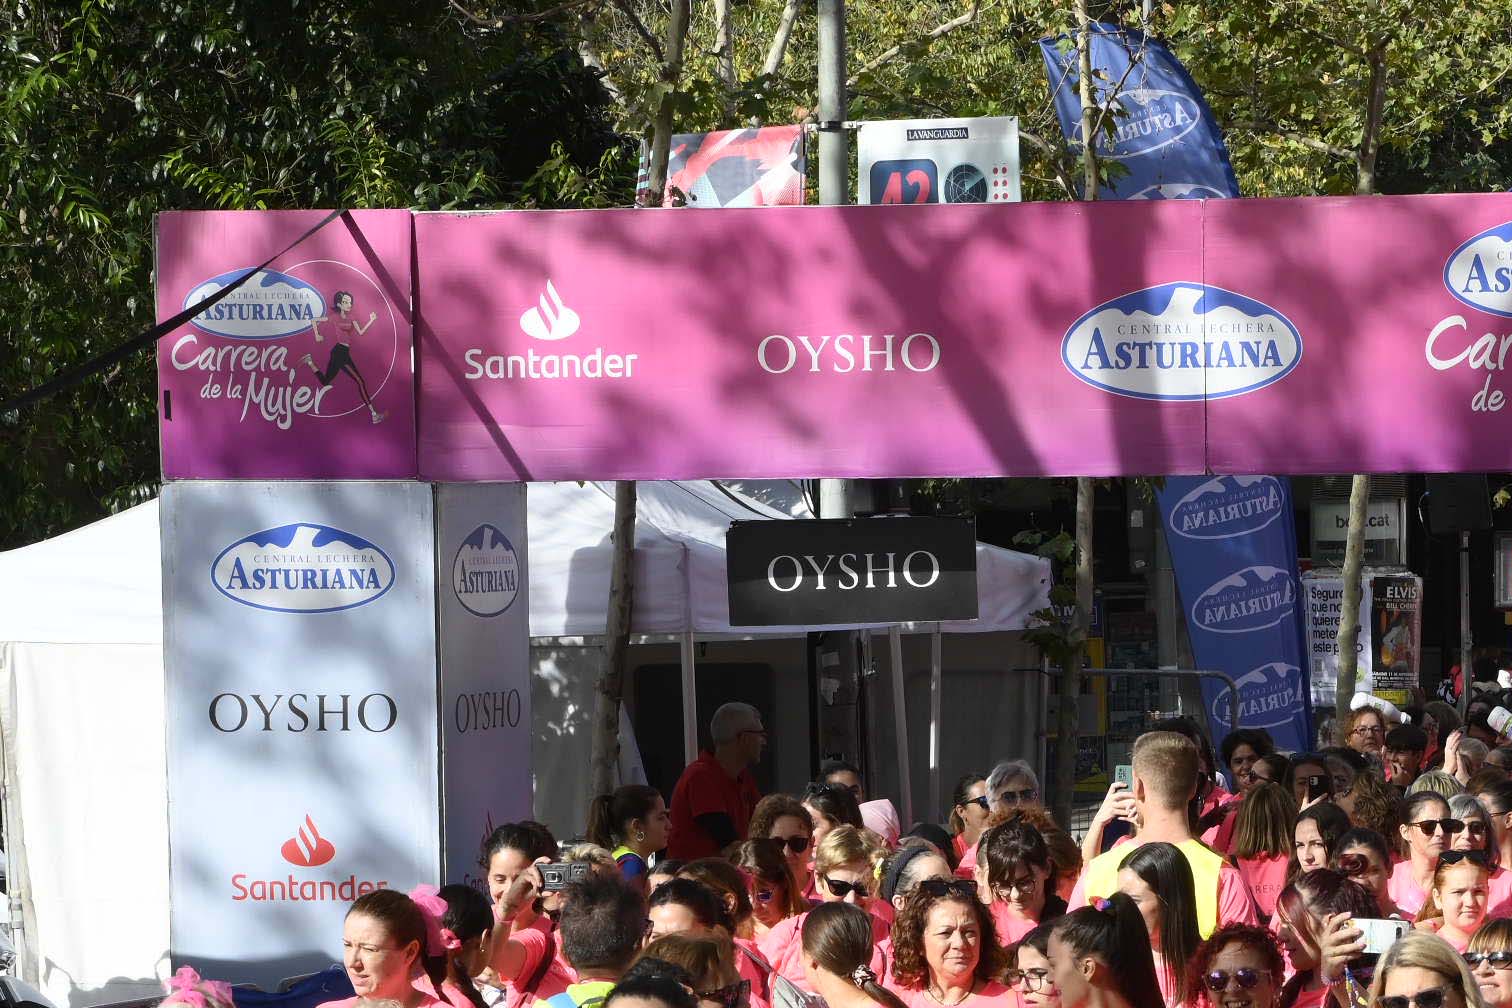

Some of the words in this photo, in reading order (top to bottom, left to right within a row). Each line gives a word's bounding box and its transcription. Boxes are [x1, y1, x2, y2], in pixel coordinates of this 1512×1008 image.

[197, 294, 314, 321] ASTURIANA
[1117, 323, 1191, 336] CENTRAL
[171, 334, 289, 371] Carrera
[465, 348, 637, 380] Santander
[757, 332, 940, 374] OYSHO
[1080, 327, 1283, 370] ASTURIANA
[200, 374, 222, 398] de
[227, 374, 242, 398] la
[240, 368, 333, 429] Mujer
[1471, 374, 1506, 412] de
[1335, 513, 1389, 528] b.cat
[226, 556, 382, 590] ASTURIANA
[458, 567, 515, 594] ASTURIANA
[767, 550, 940, 592] OYSHO
[1312, 602, 1328, 615] que
[1386, 586, 1417, 598] ELVIS
[1312, 614, 1343, 627] quiere
[1313, 641, 1332, 653] este
[208, 692, 398, 733] OYSHO
[455, 688, 521, 733] OYSHO
